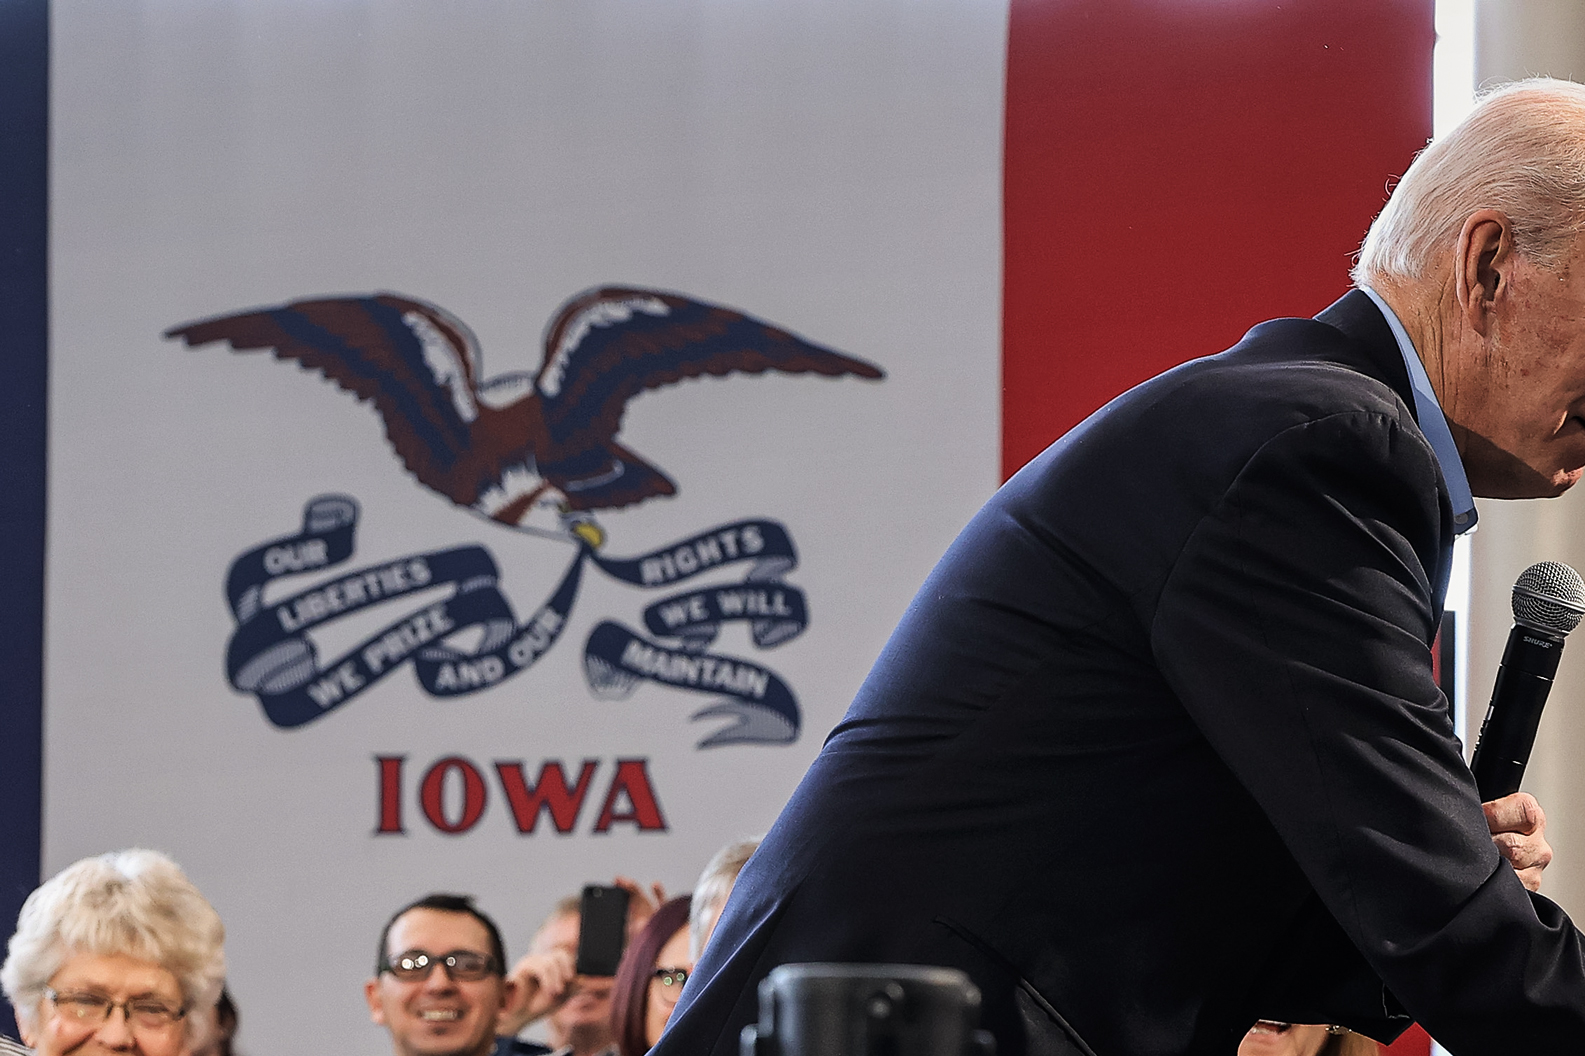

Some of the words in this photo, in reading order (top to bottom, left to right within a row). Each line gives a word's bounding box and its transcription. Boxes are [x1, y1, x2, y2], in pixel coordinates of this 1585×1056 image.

[263, 537, 329, 576] OUR
[639, 524, 766, 585] RIGHTS
[276, 557, 432, 633] LIBERTIES
[657, 593, 711, 629] WE
[715, 589, 792, 616] WILL
[306, 660, 366, 708] WE
[362, 602, 455, 675] PRIZE
[434, 654, 506, 690] AND
[507, 604, 563, 669] OUR
[621, 637, 771, 700] MAINTAIN
[372, 753, 670, 837] IOWA
